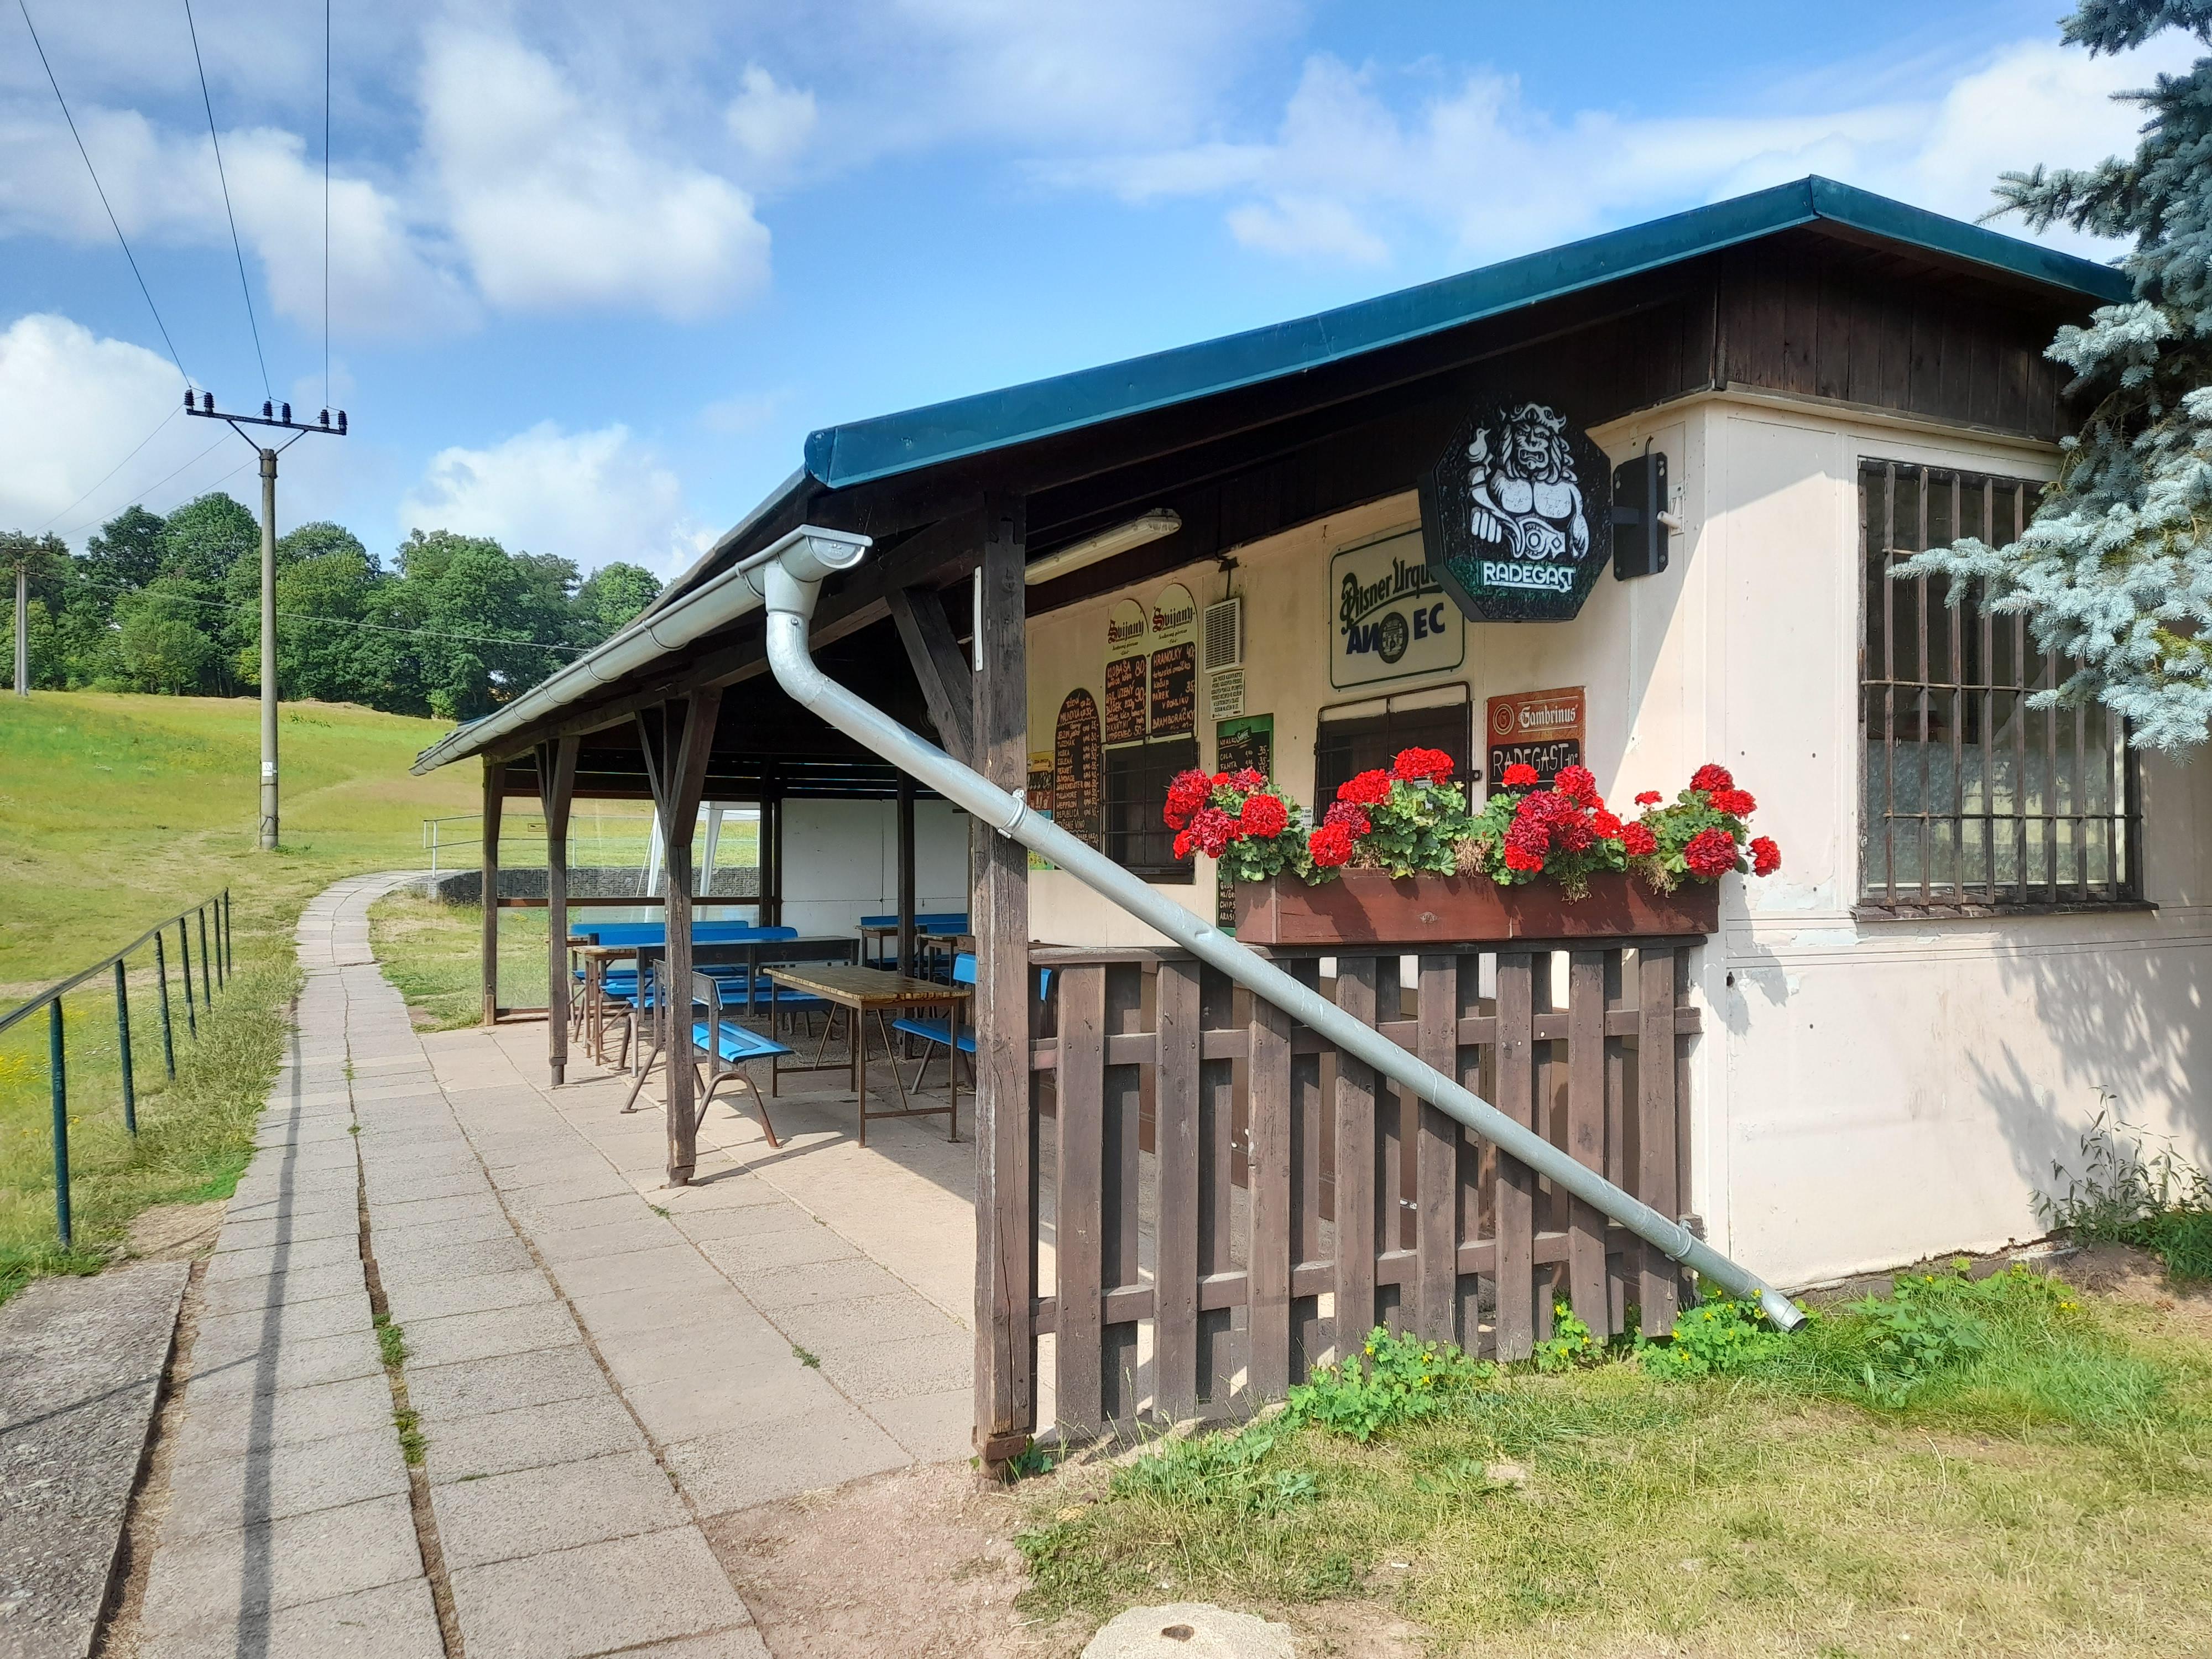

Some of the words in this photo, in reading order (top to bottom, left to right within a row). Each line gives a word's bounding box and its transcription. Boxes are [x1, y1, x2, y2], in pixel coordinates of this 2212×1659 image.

[1483, 562, 1576, 593] RADEGAST
[1340, 572, 1392, 635] Pilsner
[1154, 646, 1182, 667] HRANOLKY
[1152, 707, 1195, 729] BRAMBORÁČKY
[1518, 705, 1578, 728] Gambrinus
[1220, 753, 1233, 761] COLA
[1220, 761, 1237, 770] FANTA
